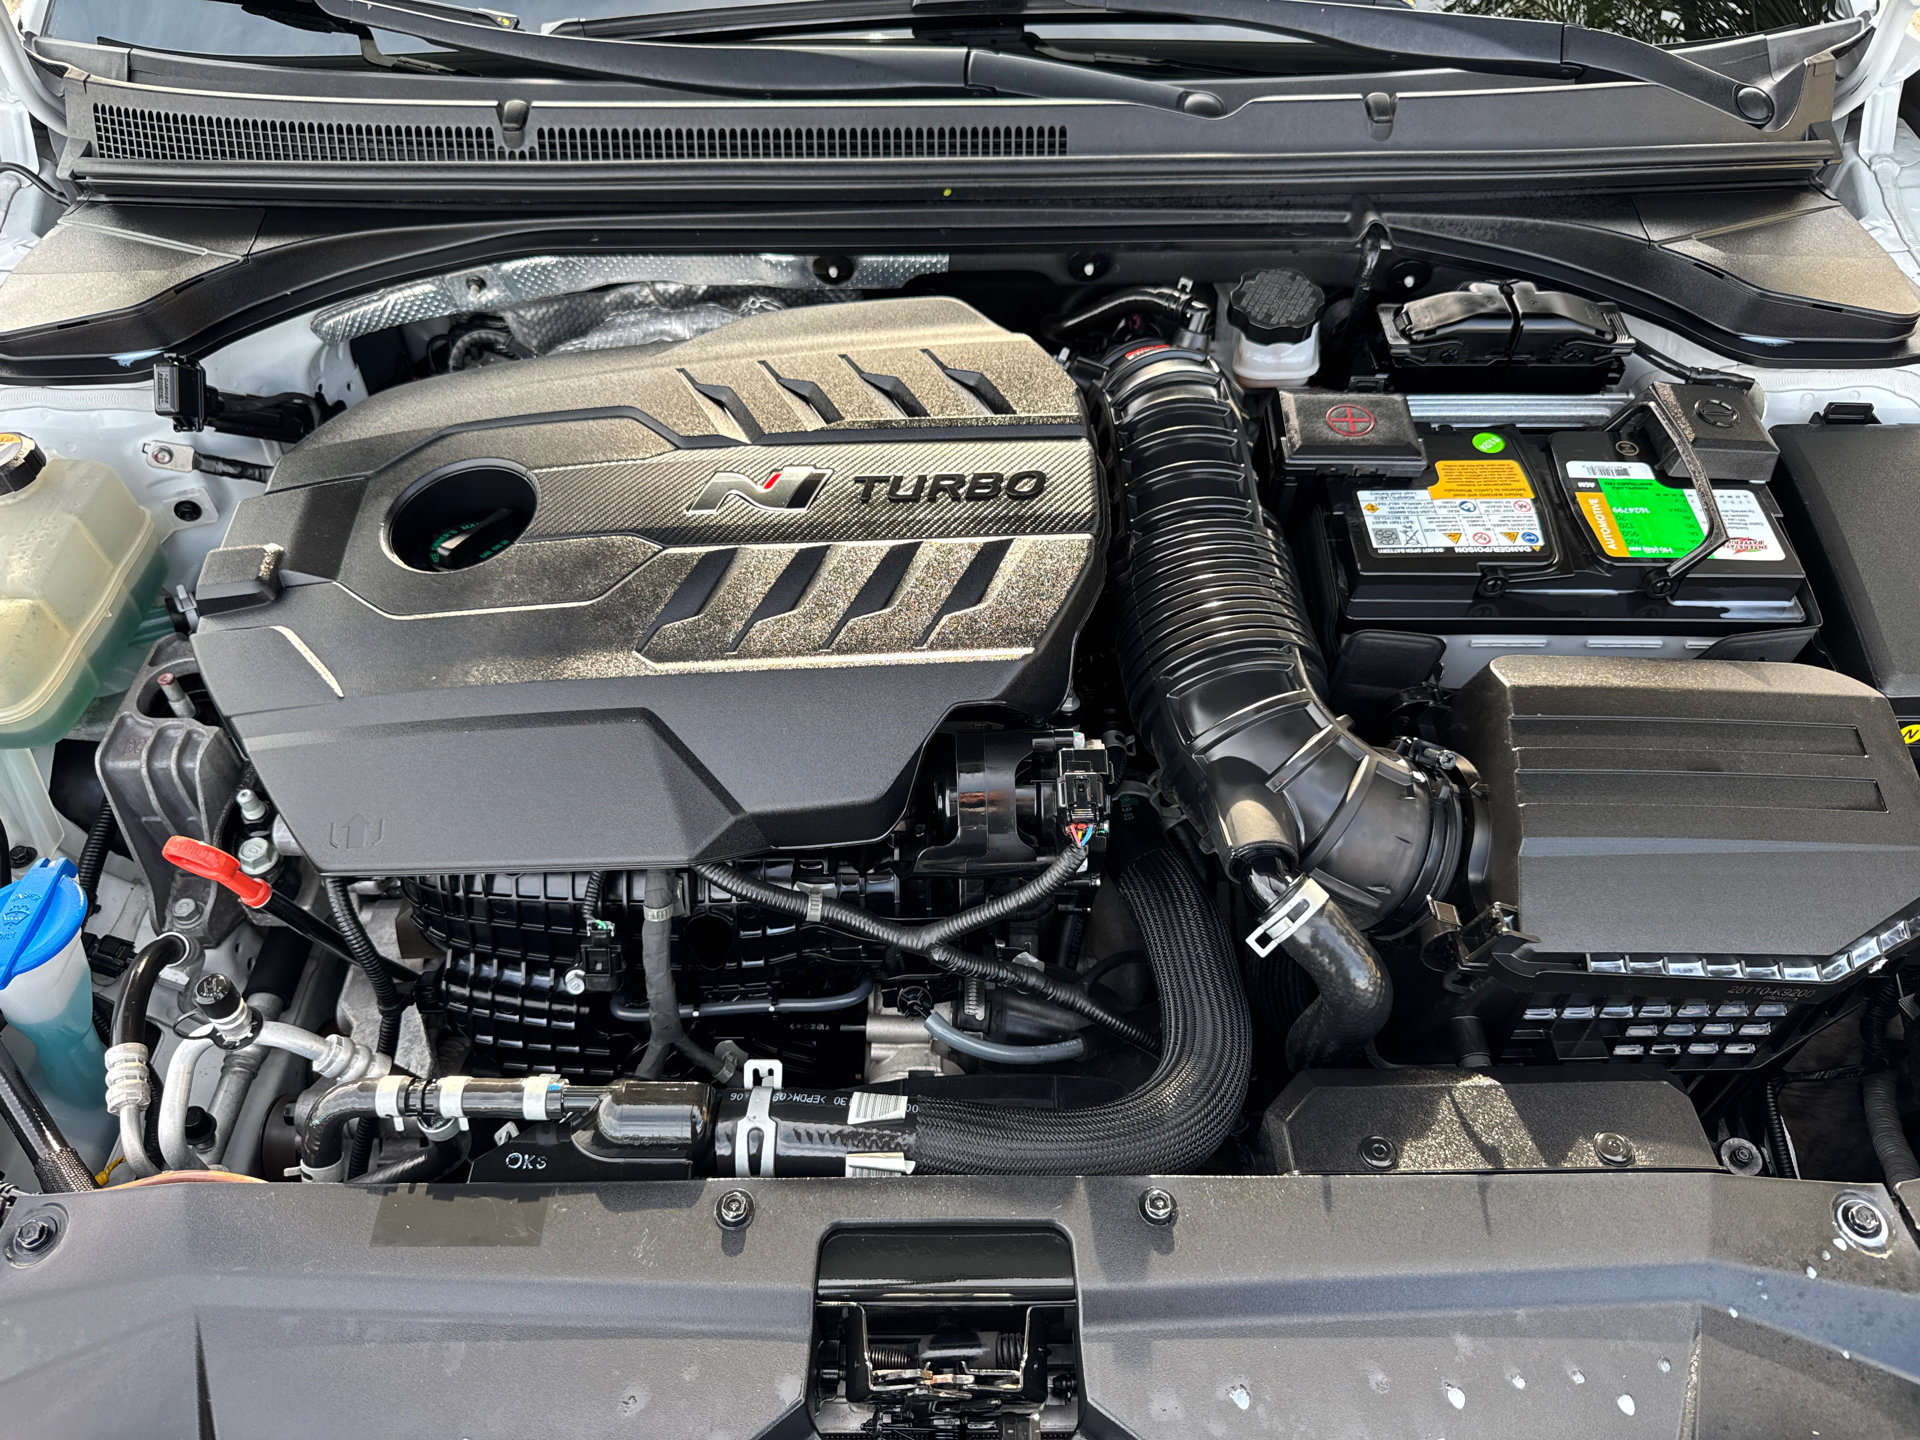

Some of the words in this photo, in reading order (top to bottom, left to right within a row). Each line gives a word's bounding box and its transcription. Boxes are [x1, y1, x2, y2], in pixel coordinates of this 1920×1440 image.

[854, 470, 1047, 503] TURBO
[1588, 498, 1618, 550] AUTOMOTIVE
[204, 977, 217, 994] H
[1726, 985, 1816, 998] 28110-K9200
[833, 1096, 848, 1106] 30
